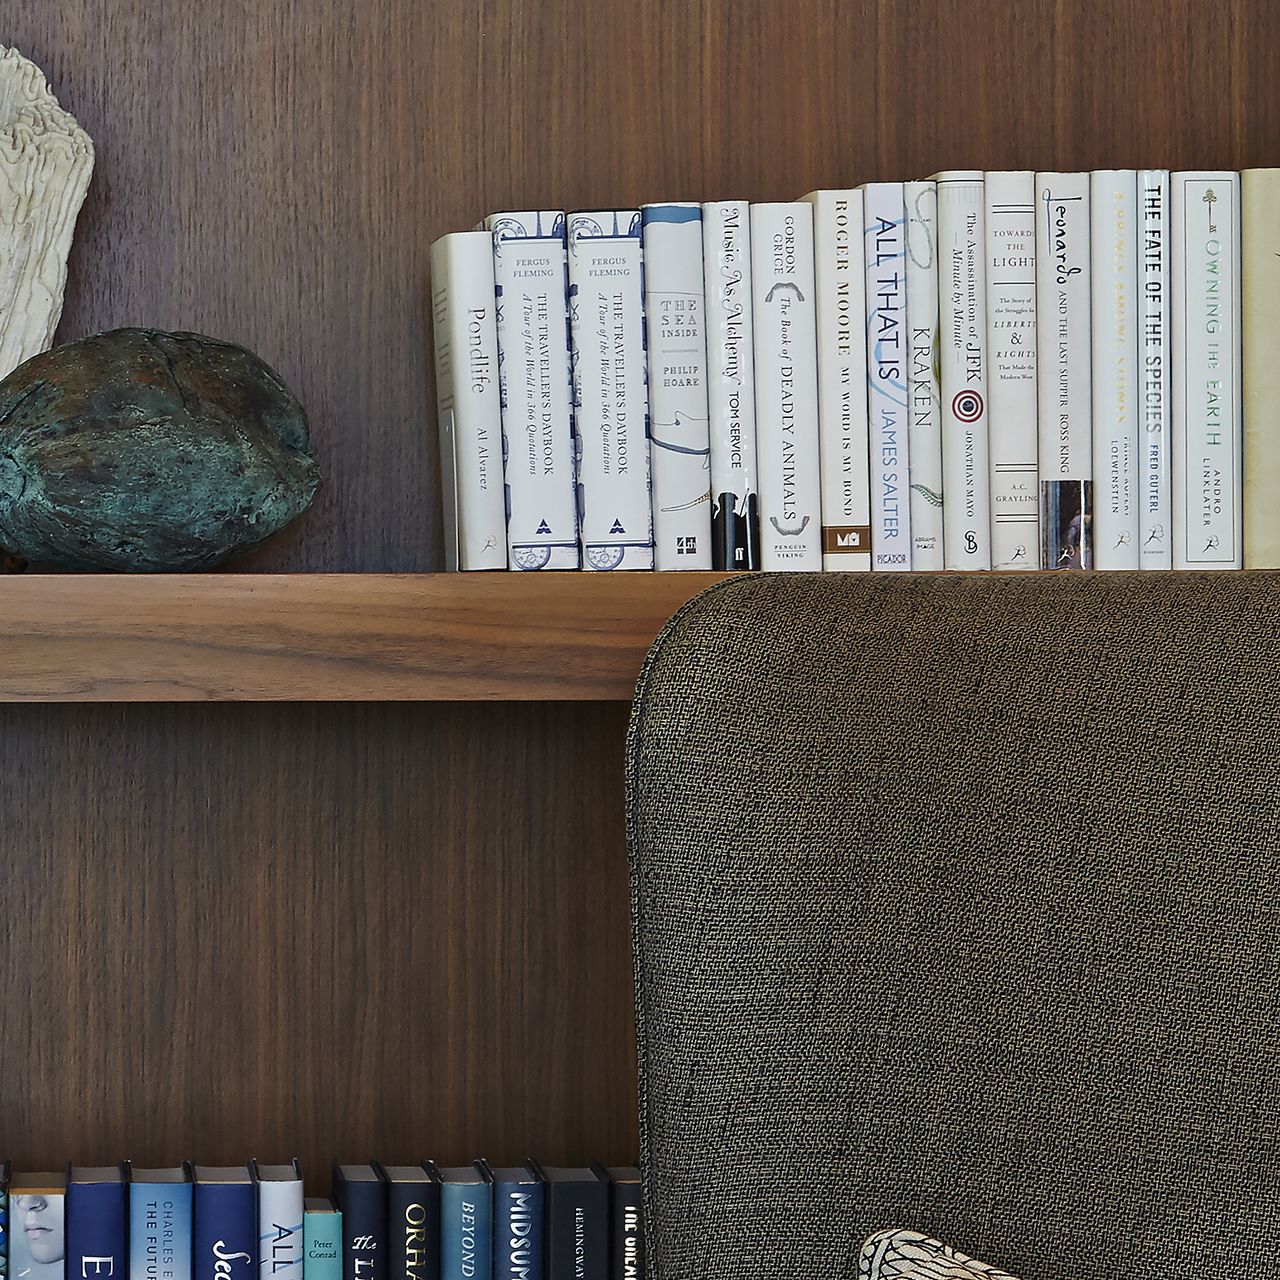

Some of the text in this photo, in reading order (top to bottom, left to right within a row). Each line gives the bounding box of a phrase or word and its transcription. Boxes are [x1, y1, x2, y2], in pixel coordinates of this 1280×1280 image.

[773, 234, 783, 274] GRICE
[785, 216, 795, 274] GORDON
[836, 201, 850, 355] ROGER MOORE
[469, 308, 491, 393] Pondlife
[1145, 185, 1163, 435] THE FATE OF THE SPECIES
[913, 327, 932, 427] KRAKEN
[781, 366, 796, 520] DEADLY ANIMALS
[881, 409, 899, 540] JAMES SALTER
[1060, 414, 1069, 473] ROSS KING
[1150, 445, 1159, 513] FRED GUTERL
[147, 1201, 157, 1229] THE
[462, 1201, 475, 1278] BEYOND
